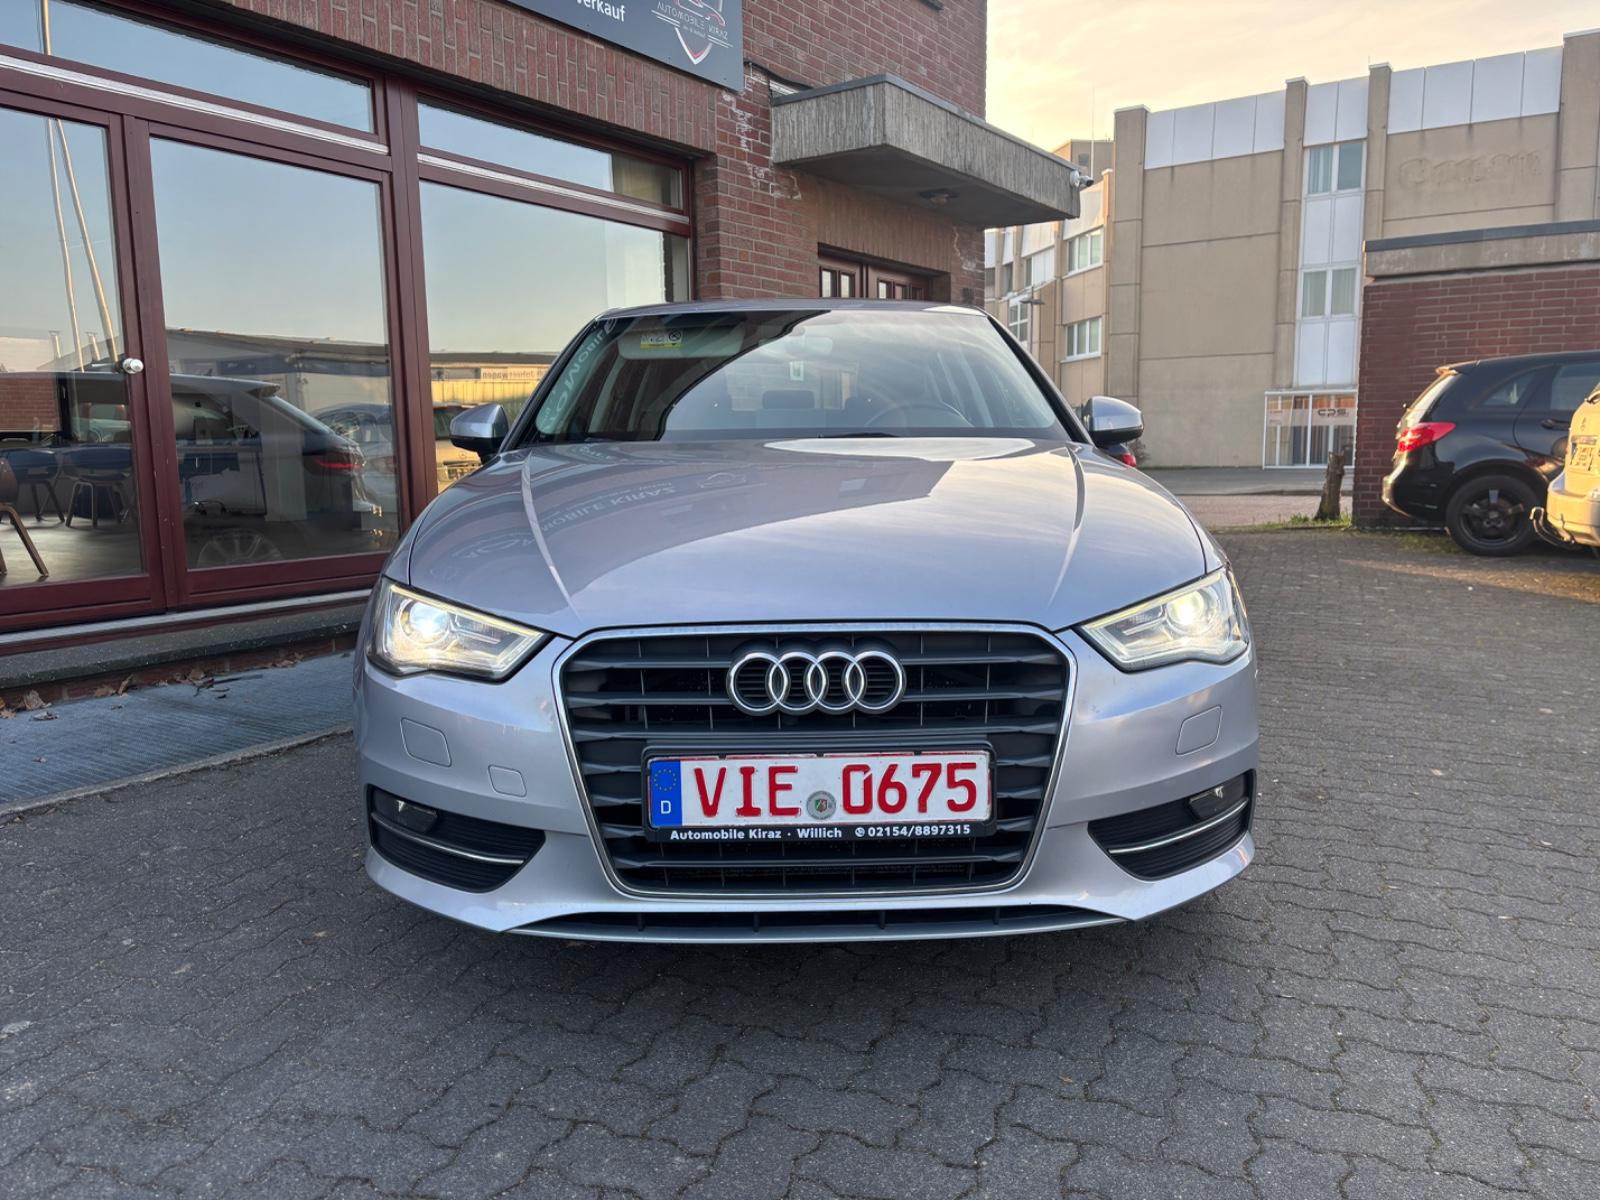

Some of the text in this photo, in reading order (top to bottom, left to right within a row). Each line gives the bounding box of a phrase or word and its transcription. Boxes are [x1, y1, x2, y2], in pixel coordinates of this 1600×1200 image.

[694, 766, 802, 818] VIE
[842, 763, 978, 815] 0675
[661, 800, 671, 814] D
[670, 825, 971, 841] Automobile Kiraz Willich 02154/8897315
